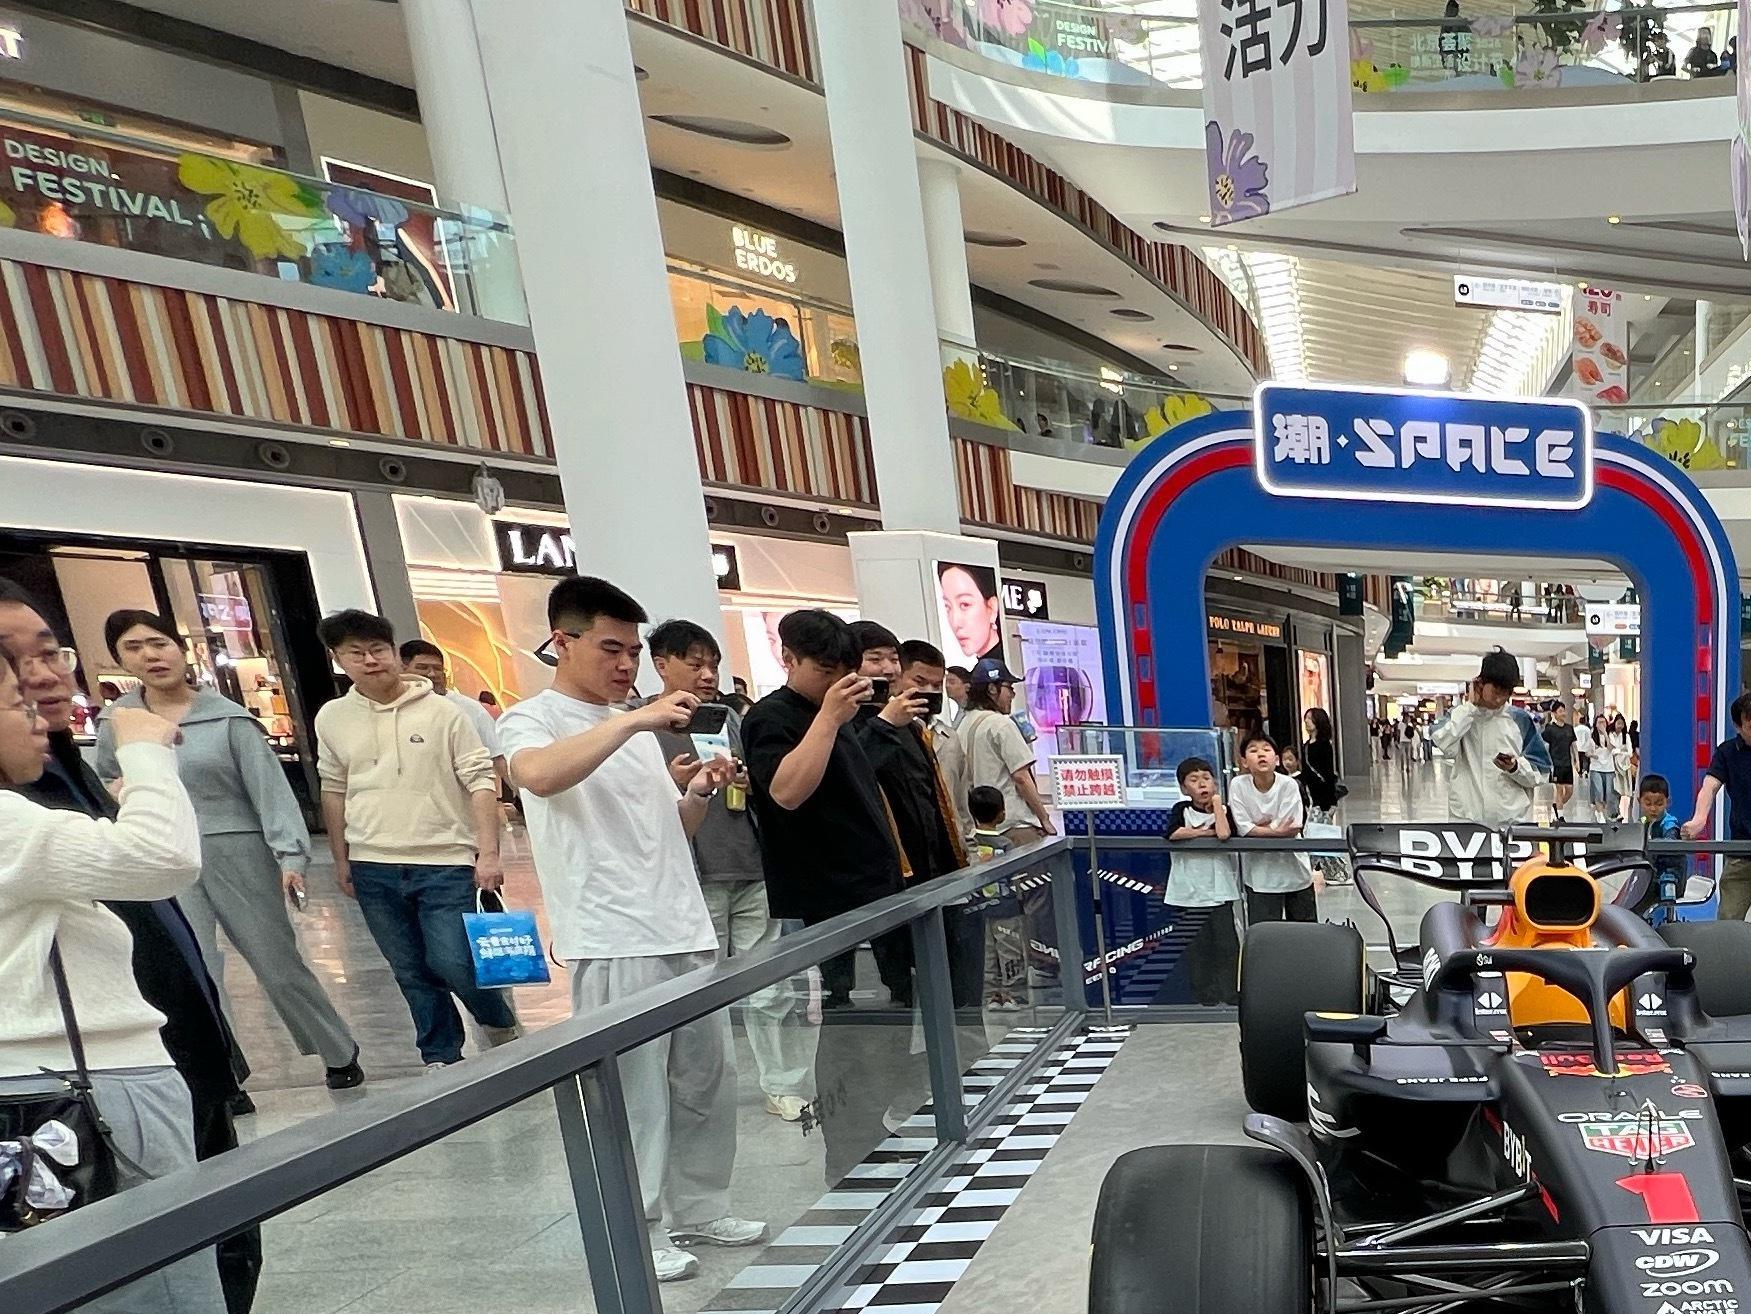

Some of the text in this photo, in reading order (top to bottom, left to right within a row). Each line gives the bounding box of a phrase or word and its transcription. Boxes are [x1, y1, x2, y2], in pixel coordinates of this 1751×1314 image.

[1055, 20, 1096, 37] DESIGN
[1219, 0, 1328, 82] 活力
[4, 139, 111, 179] DESIGN
[10, 166, 193, 226] FESTIVAL
[732, 226, 777, 258] BLUE
[735, 248, 796, 283] ERDOS
[1209, 615, 1230, 630] POLO
[1589, 1123, 1680, 1136] TAG
[1615, 1171, 1701, 1224] 1
[1630, 1227, 1715, 1247] VISA
[1635, 1252, 1702, 1272] CDW
[1639, 1279, 1734, 1298] zoom
[1679, 1299, 1739, 1312] ARCTIC
